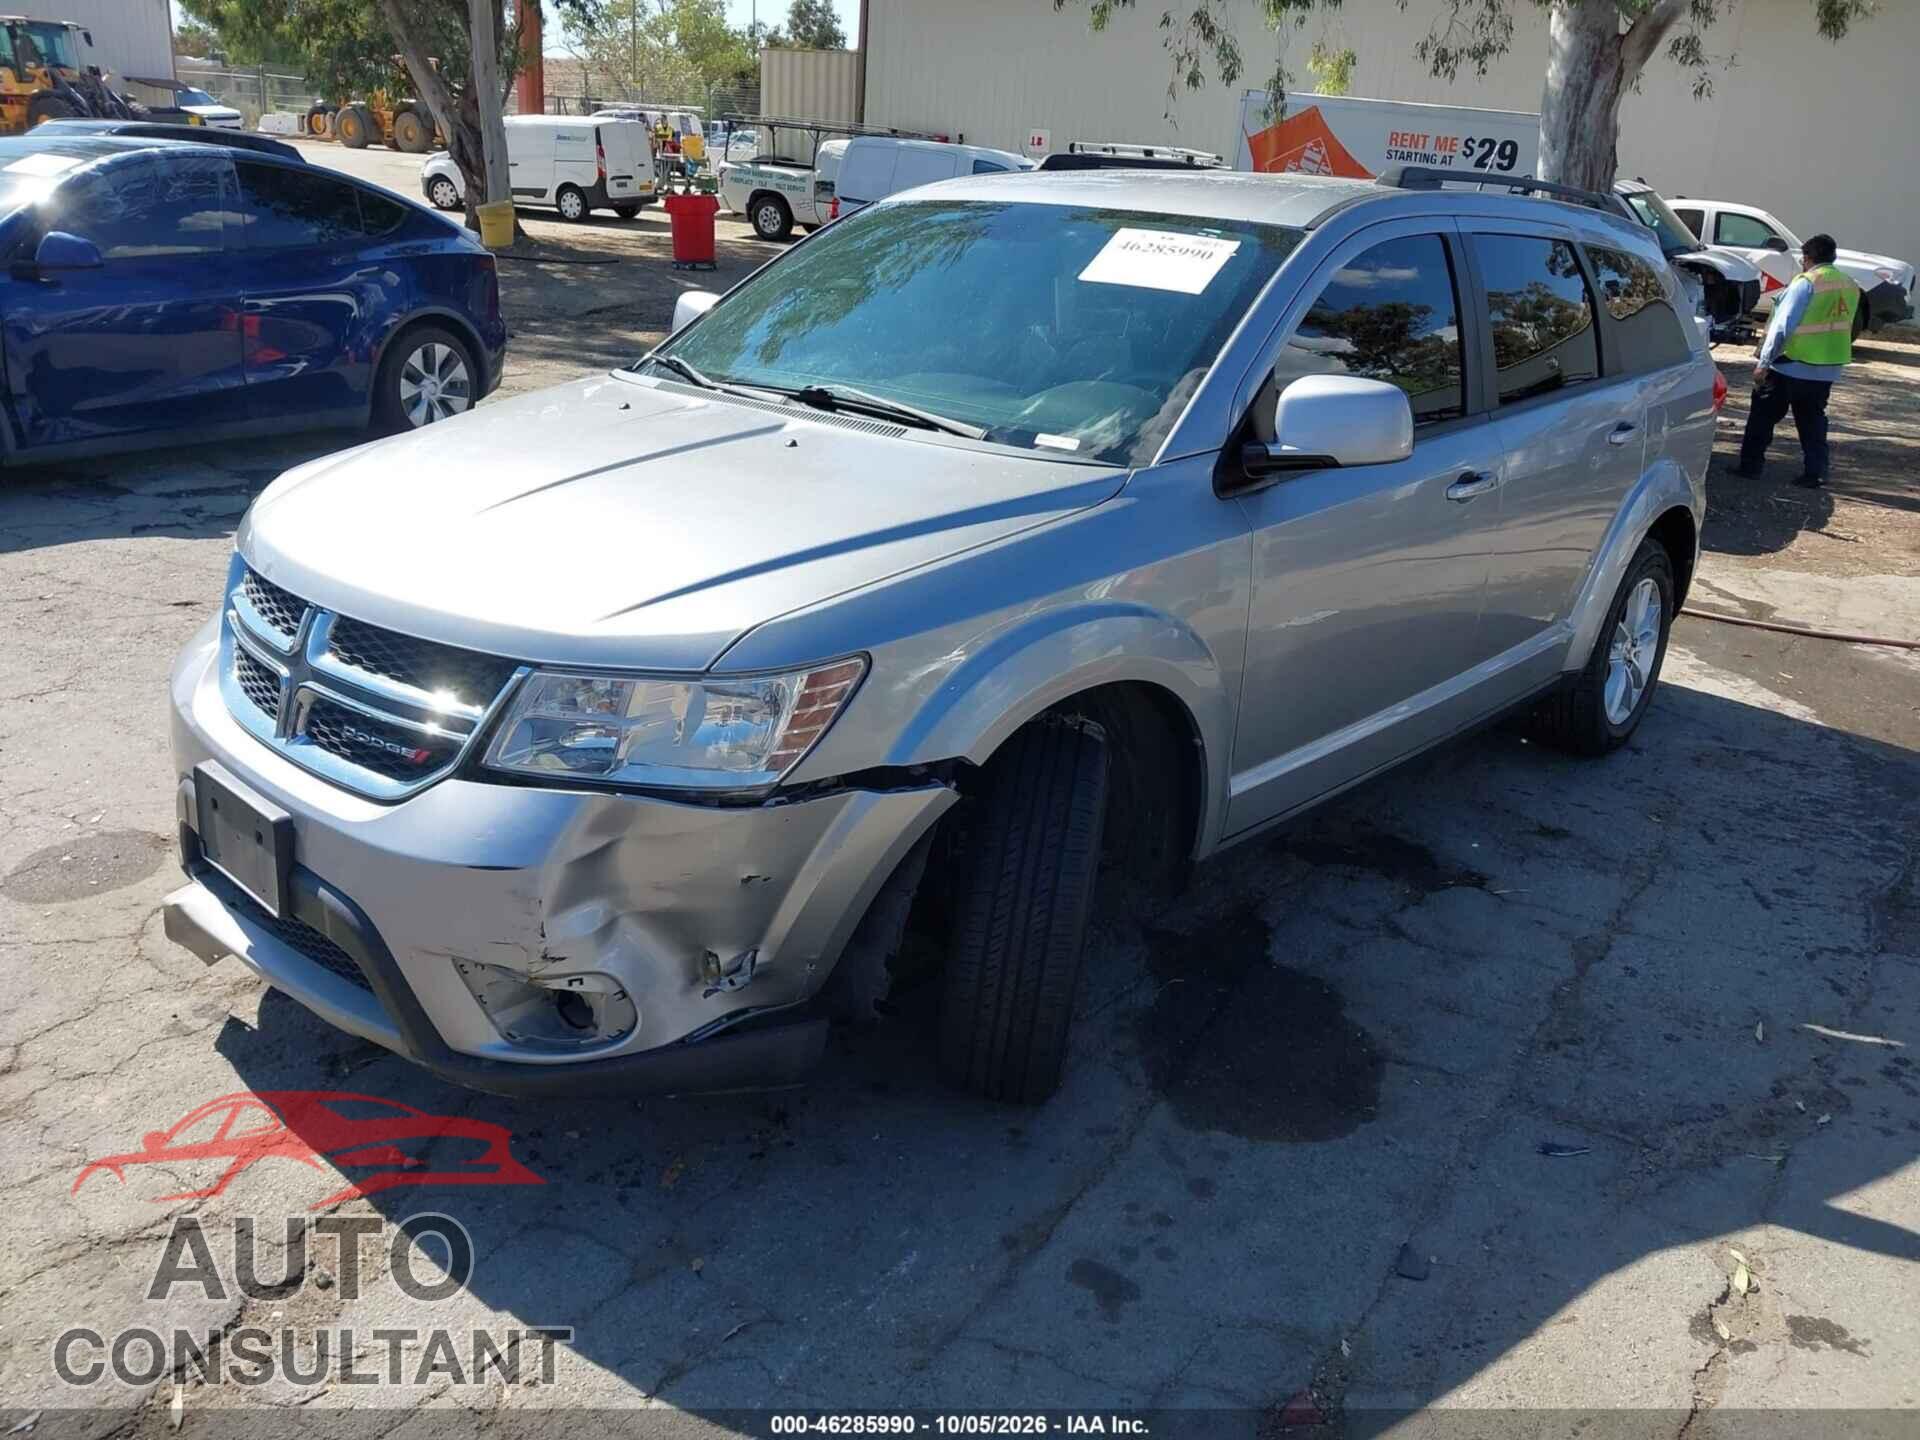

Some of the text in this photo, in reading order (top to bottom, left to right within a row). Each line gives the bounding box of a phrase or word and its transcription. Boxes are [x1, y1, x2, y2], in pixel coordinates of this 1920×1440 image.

[1389, 131, 1459, 153] RENT ME
[1462, 136, 1519, 171] $29
[1386, 149, 1455, 166] STARTING AT
[342, 724, 417, 759] DODGE
